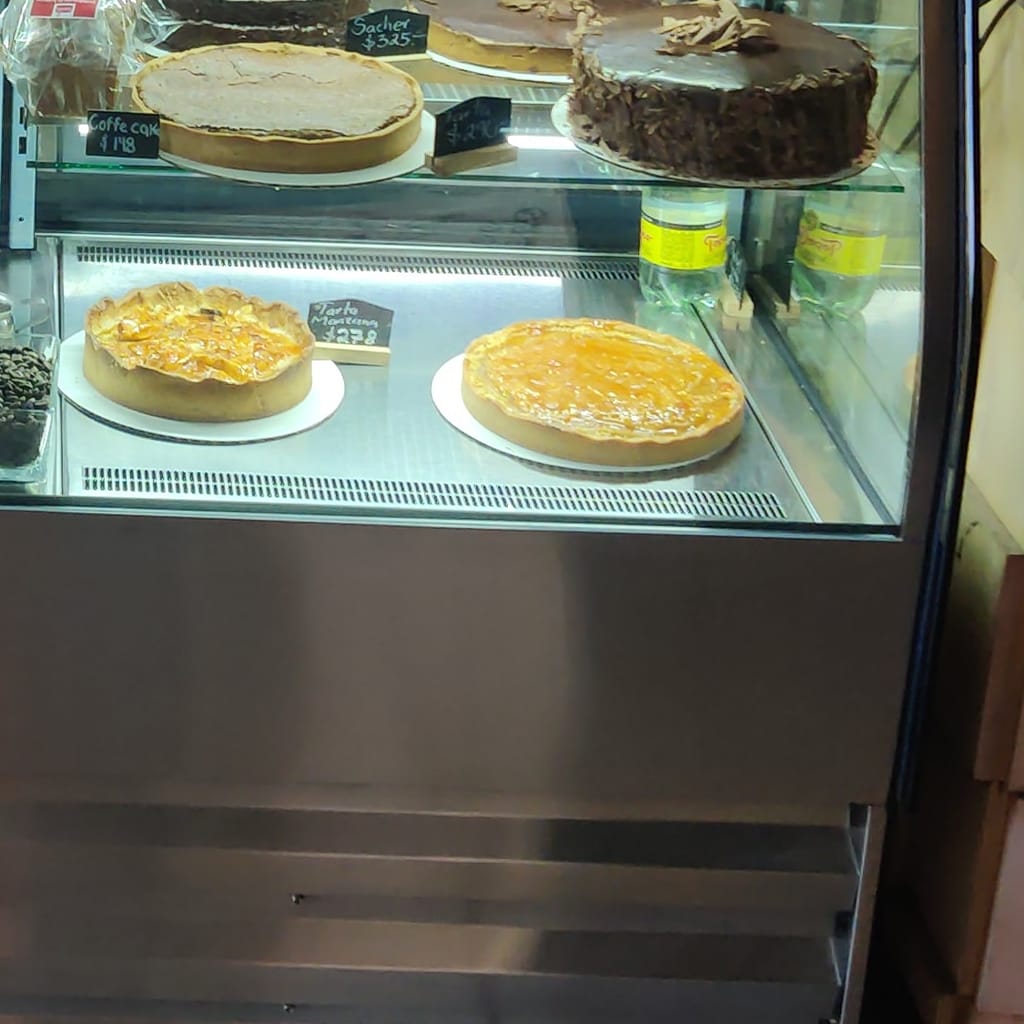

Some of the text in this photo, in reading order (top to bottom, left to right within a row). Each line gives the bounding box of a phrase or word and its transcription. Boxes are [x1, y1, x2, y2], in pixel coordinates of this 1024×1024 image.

[351, 15, 410, 36] Sacher
[88, 113, 128, 133] Coffe
[319, 301, 358, 316] Tarta
